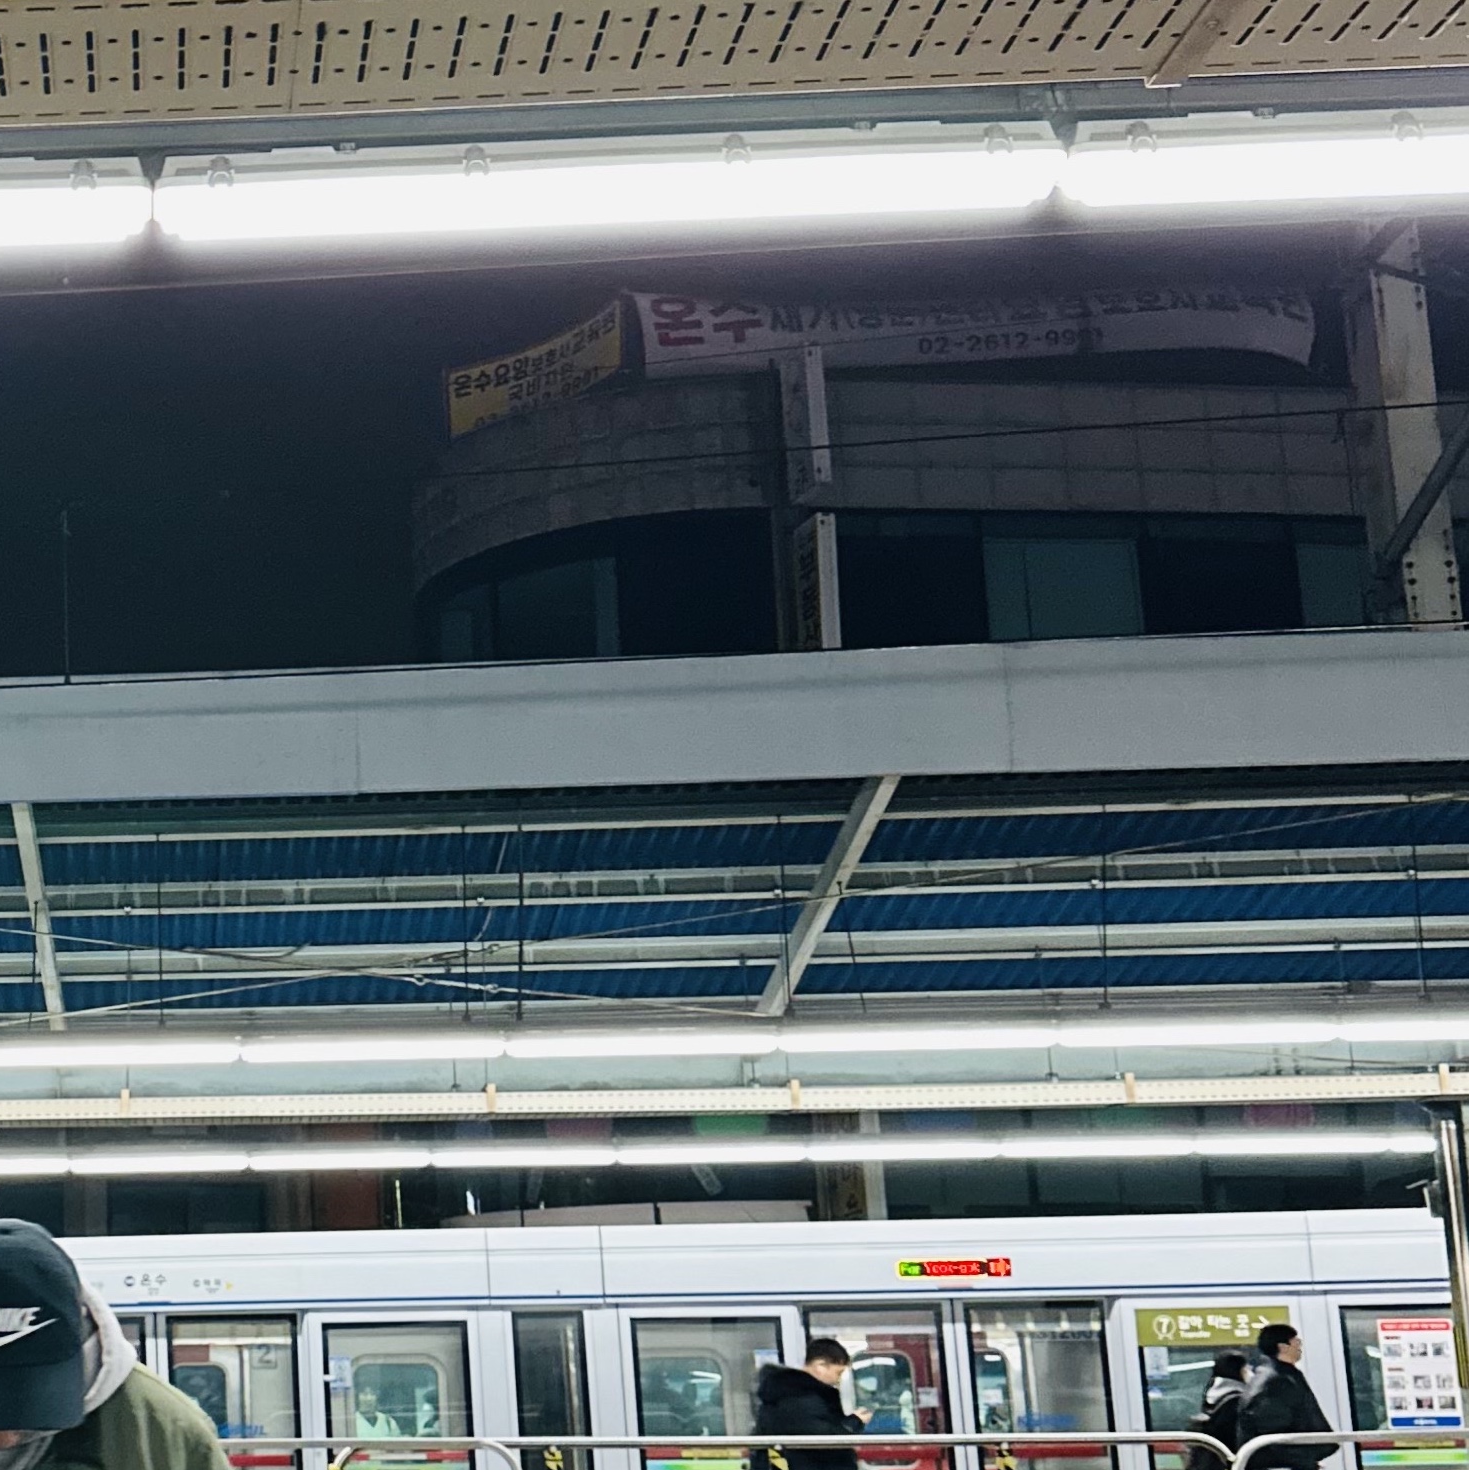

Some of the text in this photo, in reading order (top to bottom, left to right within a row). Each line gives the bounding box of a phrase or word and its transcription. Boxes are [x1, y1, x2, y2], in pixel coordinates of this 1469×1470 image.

[650, 295, 764, 348] 온수
[140, 1273, 167, 1286] 온수
[257, 1345, 273, 1364] 2
